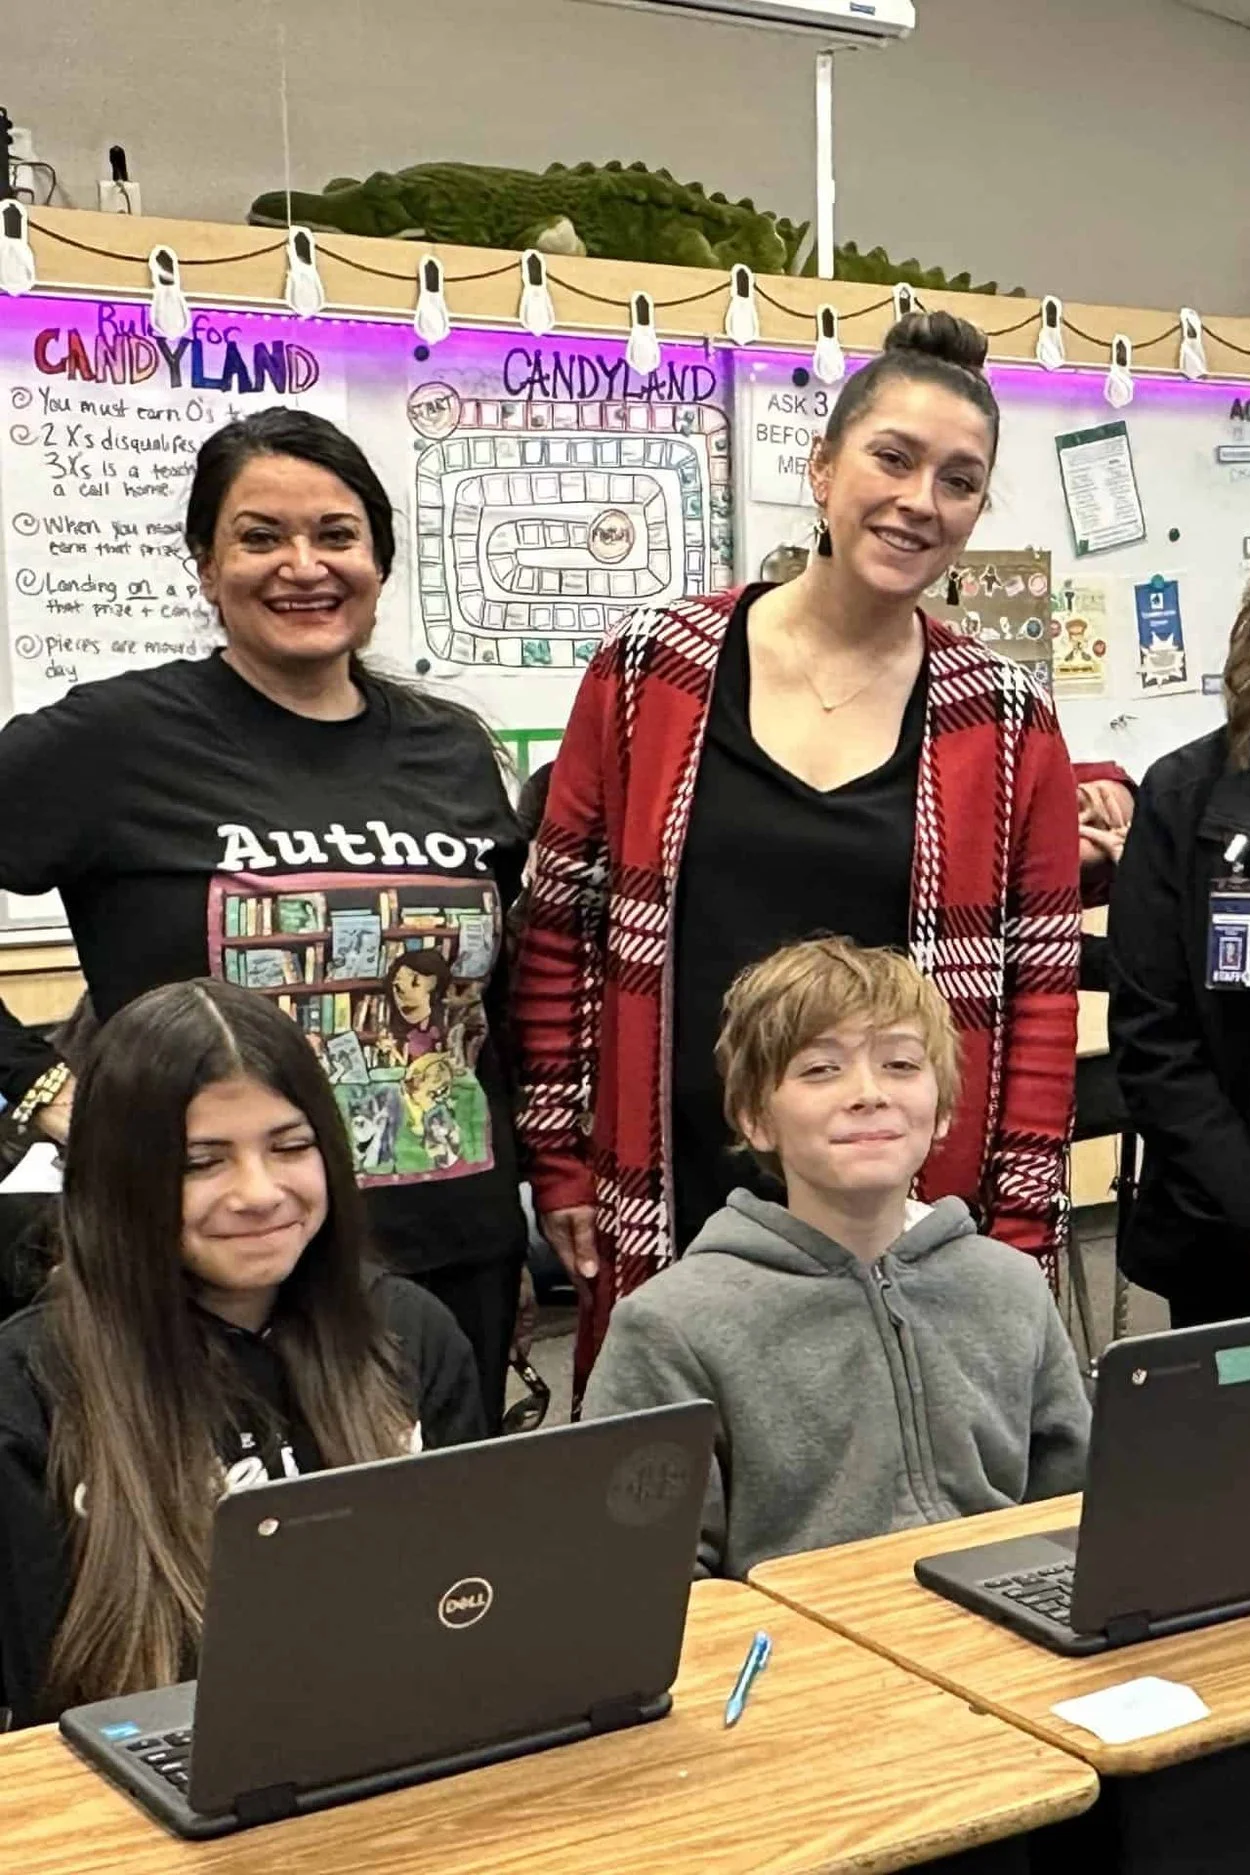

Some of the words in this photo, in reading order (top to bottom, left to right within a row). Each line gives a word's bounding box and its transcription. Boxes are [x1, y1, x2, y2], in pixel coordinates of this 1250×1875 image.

[98, 304, 155, 338] Rul
[192, 315, 242, 344] for
[34, 327, 320, 394] CANDYLAND
[503, 348, 717, 401] CANDYLAND
[38, 386, 72, 415] You
[80, 397, 130, 418] must
[768, 393, 808, 415] ASK
[813, 391, 829, 417] 3
[40, 422, 58, 447] 2
[756, 423, 812, 447] BEFO
[129, 465, 140, 479] a
[778, 454, 809, 476] ME
[53, 484, 66, 498] a
[79, 480, 111, 498] call
[43, 515, 102, 536] When
[46, 572, 118, 603] Landing
[46, 599, 85, 616] that
[45, 658, 79, 683] day
[216, 820, 496, 873] Author
[445, 1592, 486, 1615] DELL
